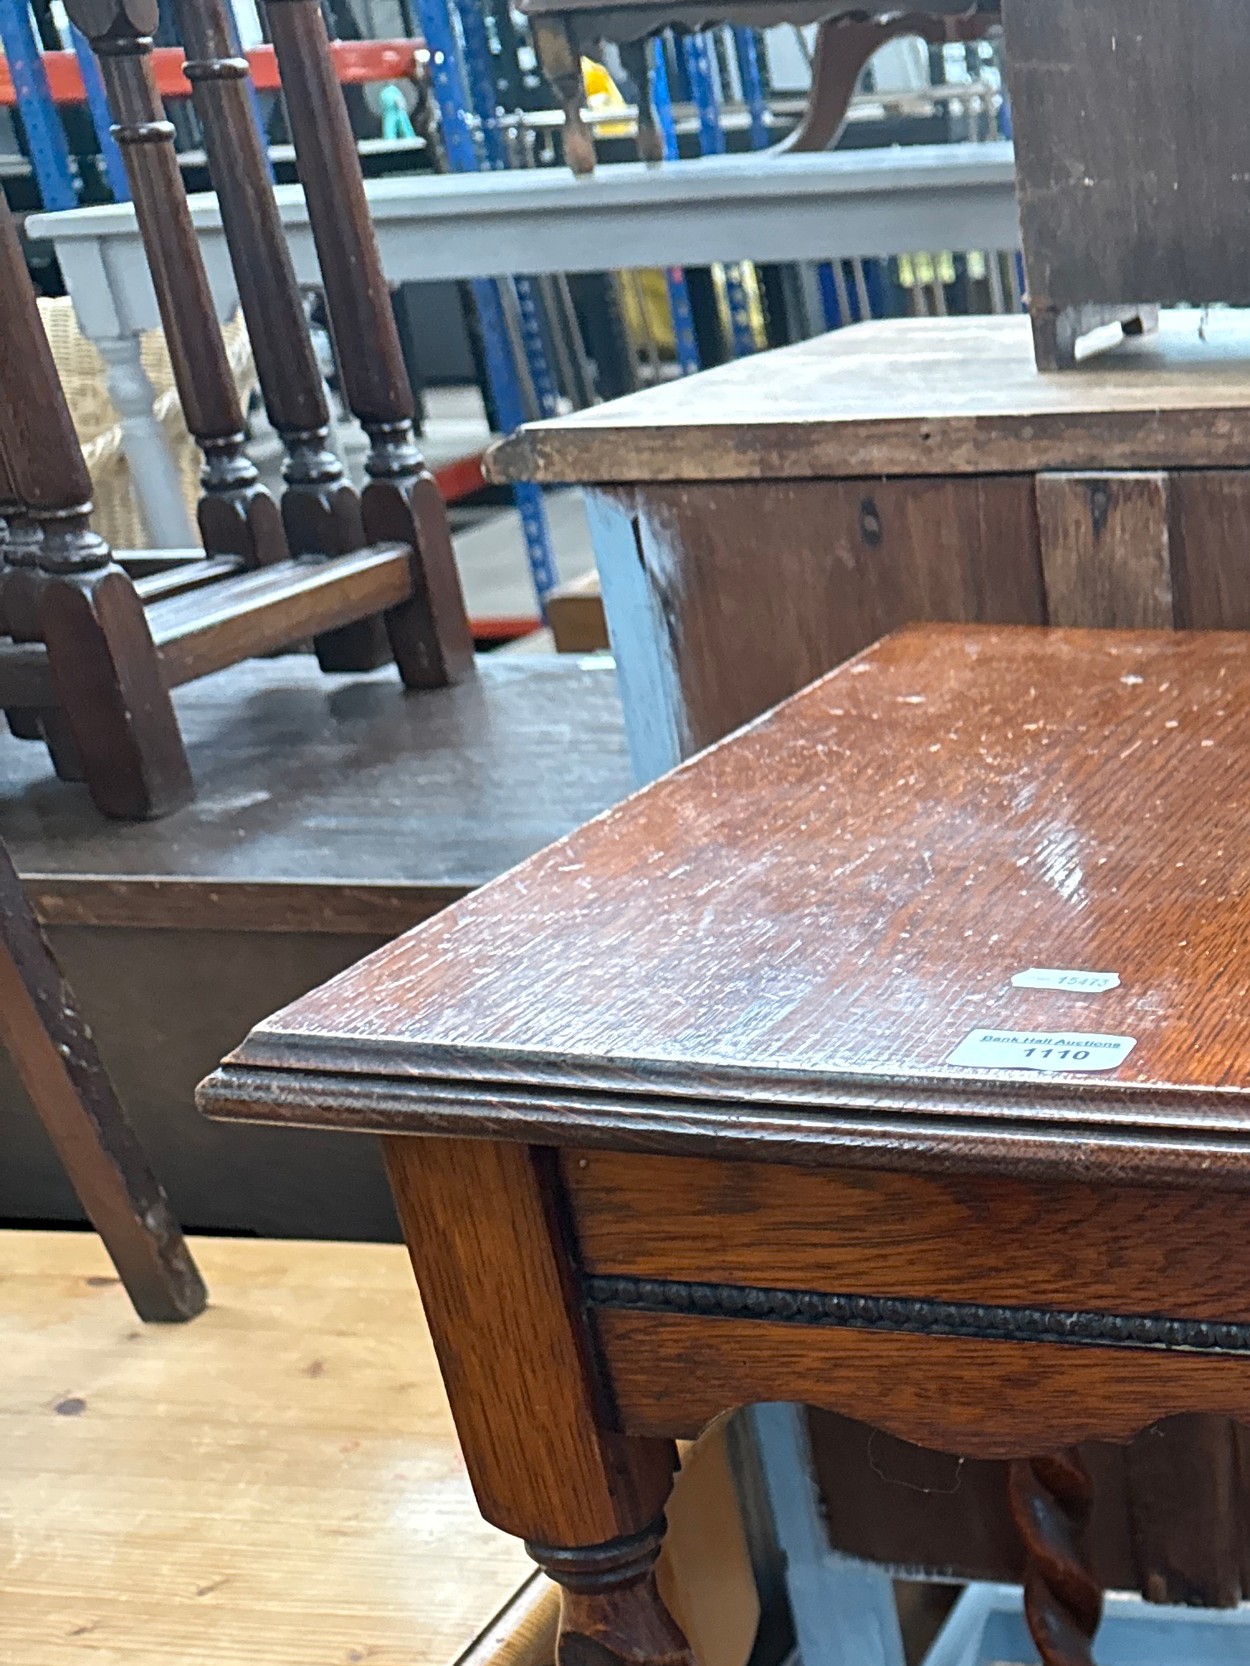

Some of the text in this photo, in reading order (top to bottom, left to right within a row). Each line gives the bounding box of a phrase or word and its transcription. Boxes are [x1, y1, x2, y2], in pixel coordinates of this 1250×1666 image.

[981, 1035, 1121, 1048] Bank Hall Auctions
[1023, 1047, 1090, 1060] 1110
